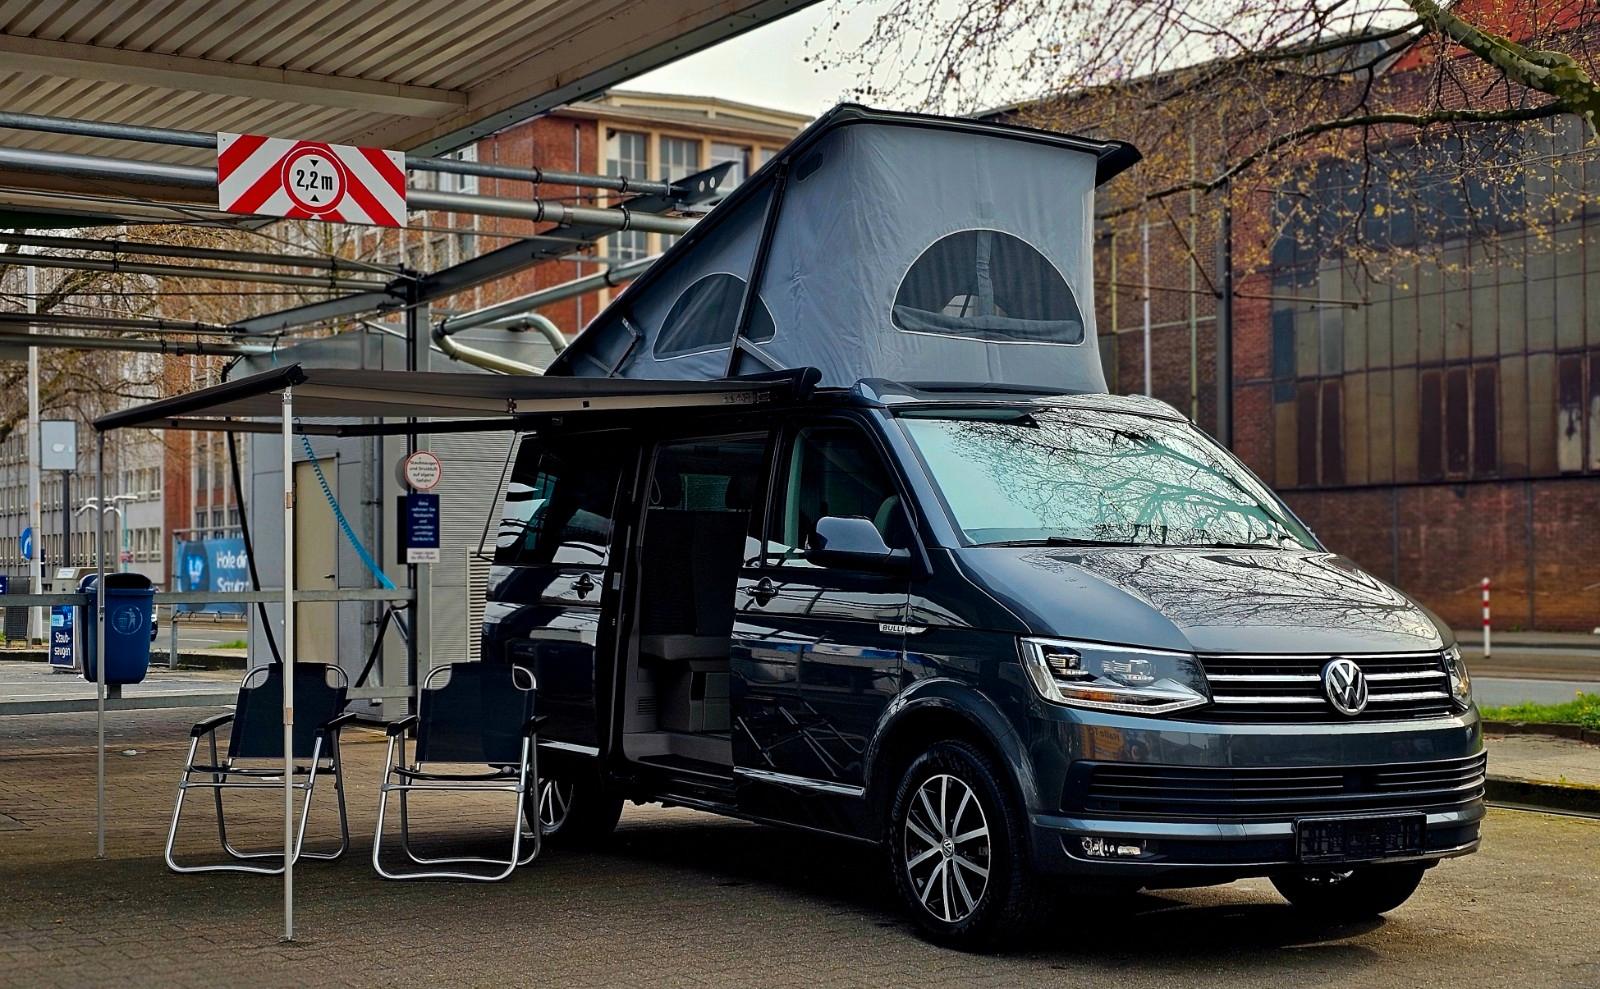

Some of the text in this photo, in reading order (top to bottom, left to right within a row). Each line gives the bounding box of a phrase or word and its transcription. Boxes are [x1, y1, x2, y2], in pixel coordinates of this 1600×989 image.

[296, 169, 333, 191] 2,2 m
[216, 550, 235, 568] Hole
[882, 624, 905, 632] BULLI
[1326, 659, 1368, 716] VW
